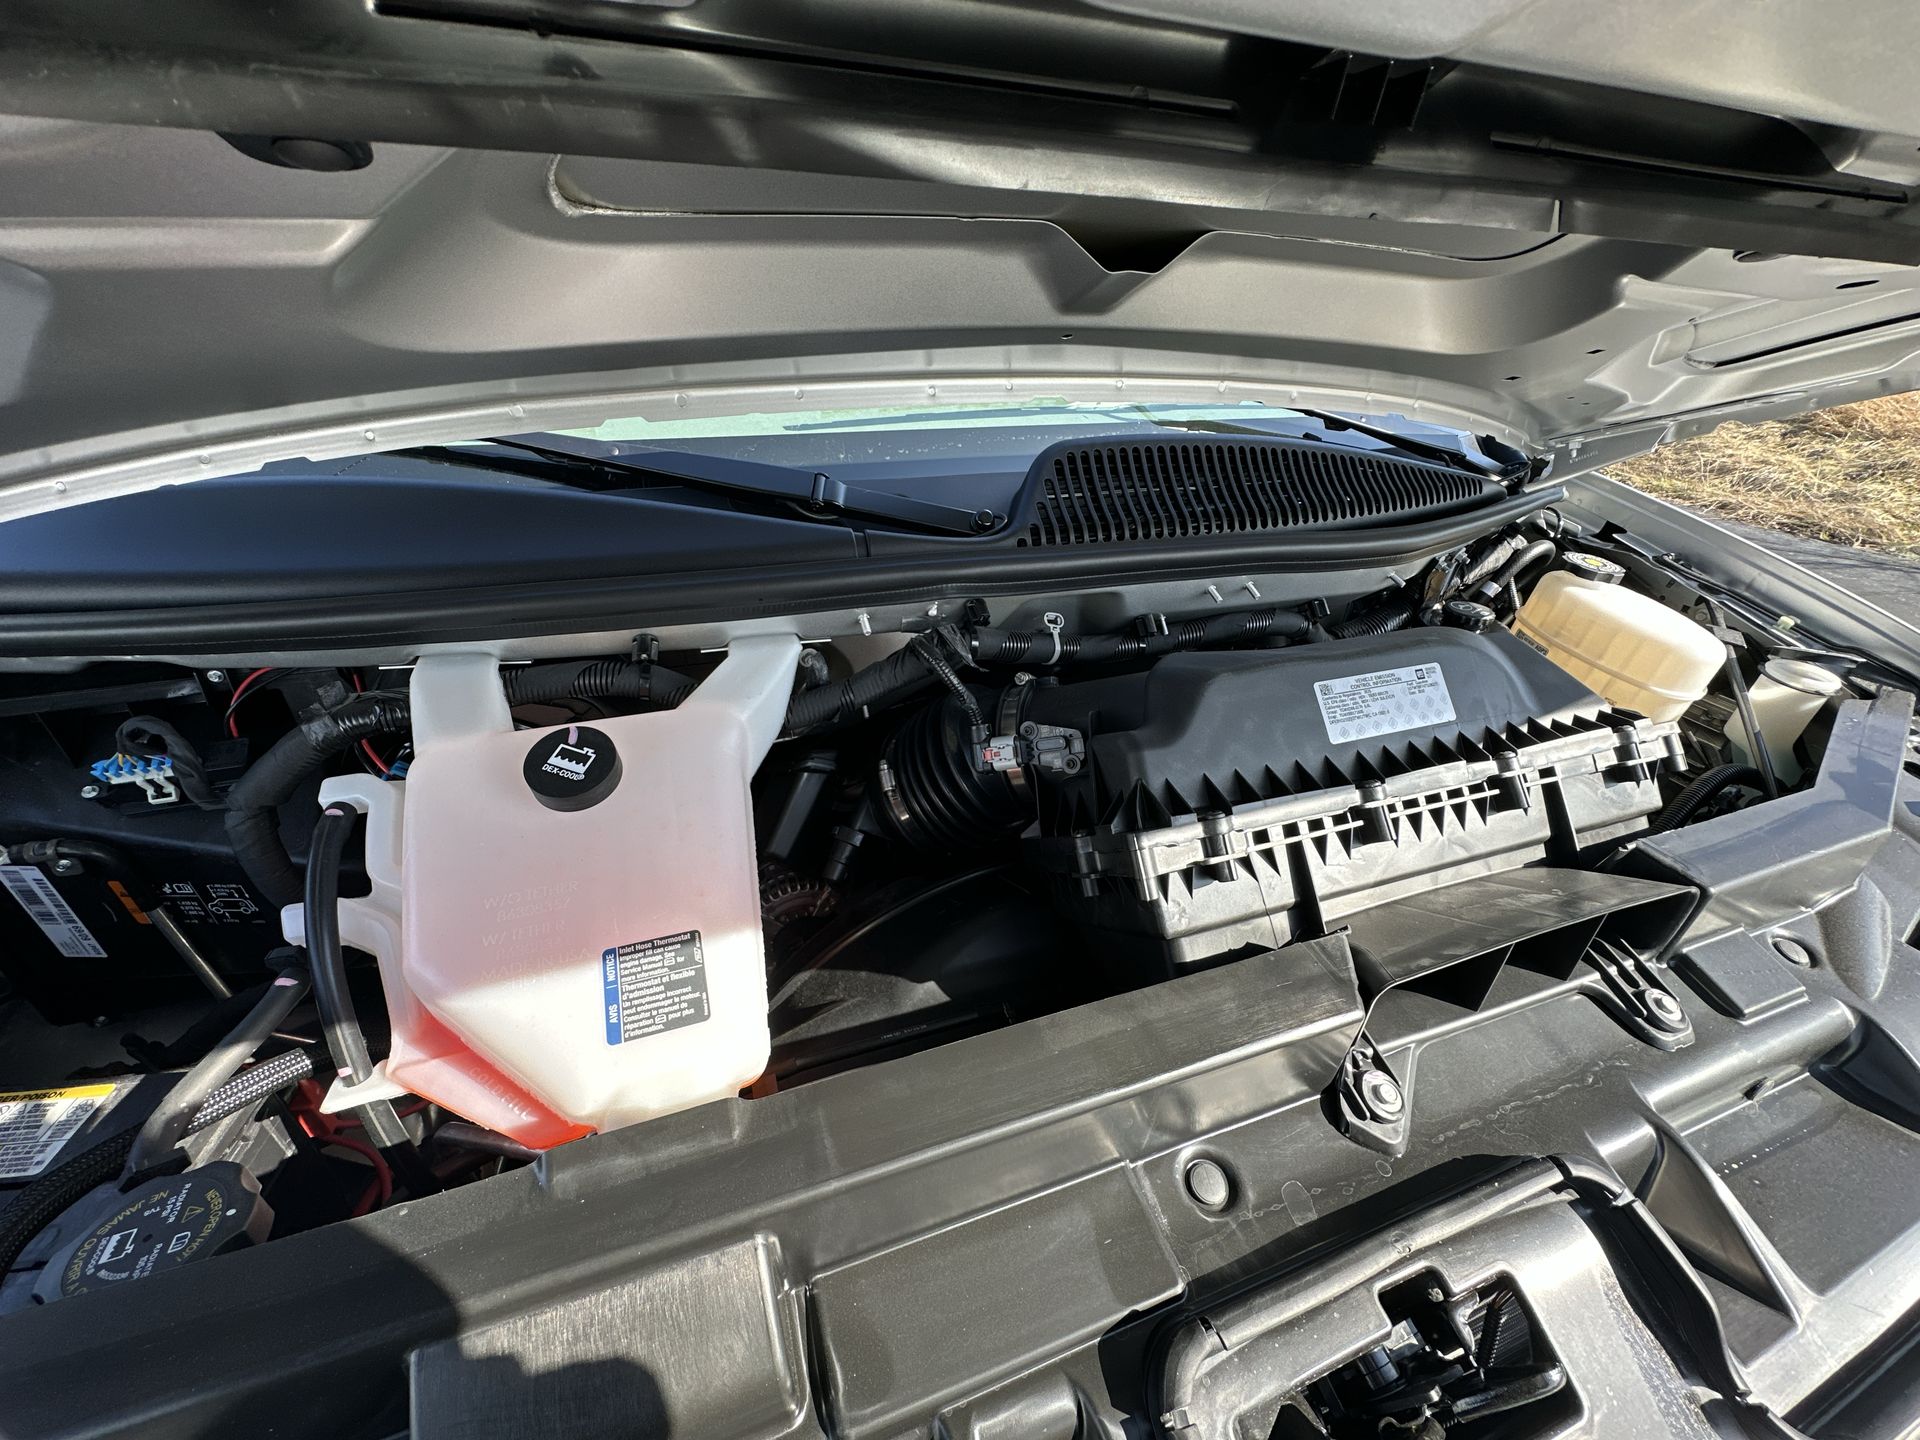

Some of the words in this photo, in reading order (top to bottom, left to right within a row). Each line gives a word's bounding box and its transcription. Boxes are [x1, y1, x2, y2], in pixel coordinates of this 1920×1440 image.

[1350, 682, 1372, 690] CONTROL
[1372, 677, 1402, 686] INFORMATION
[619, 946, 635, 954] Inlet
[635, 942, 652, 951] Hose
[653, 932, 691, 947] Thermostat
[619, 951, 645, 961] Improper
[664, 943, 682, 952] cause
[605, 953, 616, 983] NOTICE
[620, 960, 640, 968] engine
[620, 965, 642, 975] Service
[642, 961, 663, 970] Manual
[622, 977, 662, 992] Thermostat
[670, 970, 696, 980] flexible
[622, 985, 665, 1000] d'admission
[631, 993, 666, 1005] remplissage
[666, 985, 692, 995] incorrect
[609, 1003, 619, 1024] AVIS
[623, 1007, 637, 1016] peut
[637, 998, 674, 1011] endommager
[623, 1011, 651, 1022] Consulter
[658, 1003, 680, 1013] manuel
[624, 1018, 654, 1030] réparation
[668, 1012, 682, 1020] pour
[682, 1008, 695, 1017] plus
[166, 1183, 192, 1224] RADIATOR
[205, 1189, 222, 1211] NEVER
[97, 1199, 146, 1235] JAMAIS
[202, 1211, 221, 1239] OPEN
[66, 1239, 97, 1283] OUVRIR
[140, 1242, 163, 1279] RADIATE
